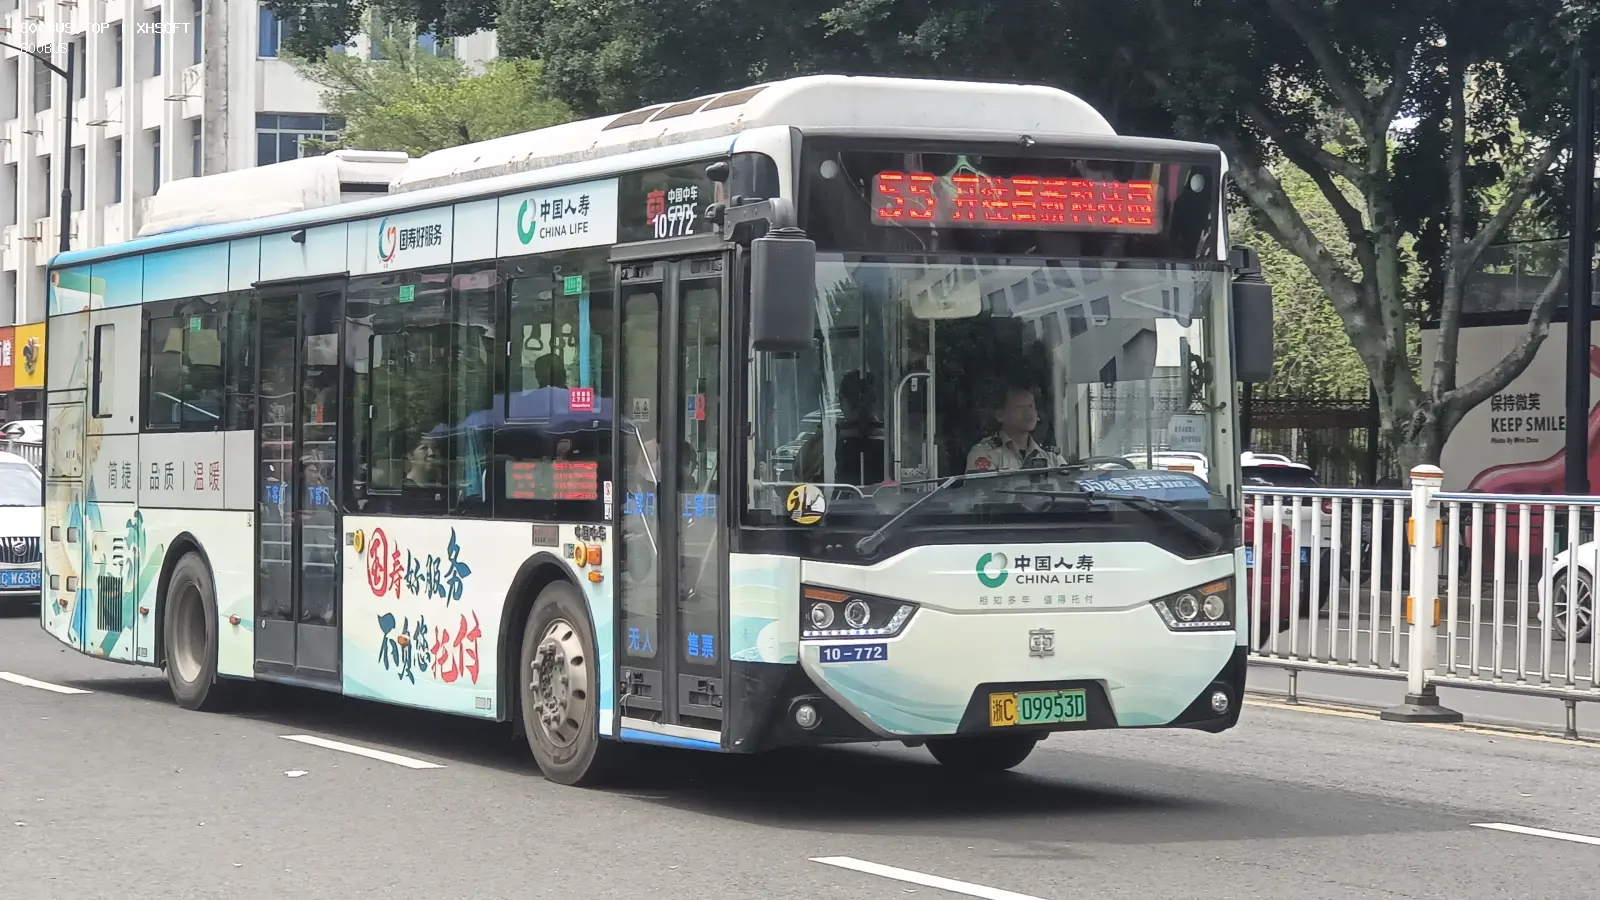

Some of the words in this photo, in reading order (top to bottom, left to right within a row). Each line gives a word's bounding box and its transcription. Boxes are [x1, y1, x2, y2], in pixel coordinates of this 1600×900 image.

[540, 193, 591, 222] 中国人寿
[667, 184, 699, 204] 中国中车
[878, 172, 934, 219] 55
[399, 223, 442, 251] 国寿好服务
[540, 224, 567, 239] CHINA
[569, 221, 589, 235] LIFE
[652, 210, 694, 239] 10772
[1491, 393, 1540, 412] 保持微笑
[1491, 417, 1523, 432] KEEP
[1526, 415, 1566, 431] SMILE
[108, 460, 132, 490] 简捷
[149, 461, 175, 492] 品质
[193, 461, 221, 491] 温暖
[366, 526, 472, 608] 国寿好服务
[1014, 554, 1094, 572] 中国人寿
[1015, 574, 1060, 585] CHINA
[1064, 573, 1094, 584] LIFE
[377, 610, 481, 686] 不负您托付
[628, 627, 654, 653] 无人
[687, 632, 714, 659] 售票
[823, 646, 883, 661] 10-772
[1022, 694, 1085, 720] 09953D
